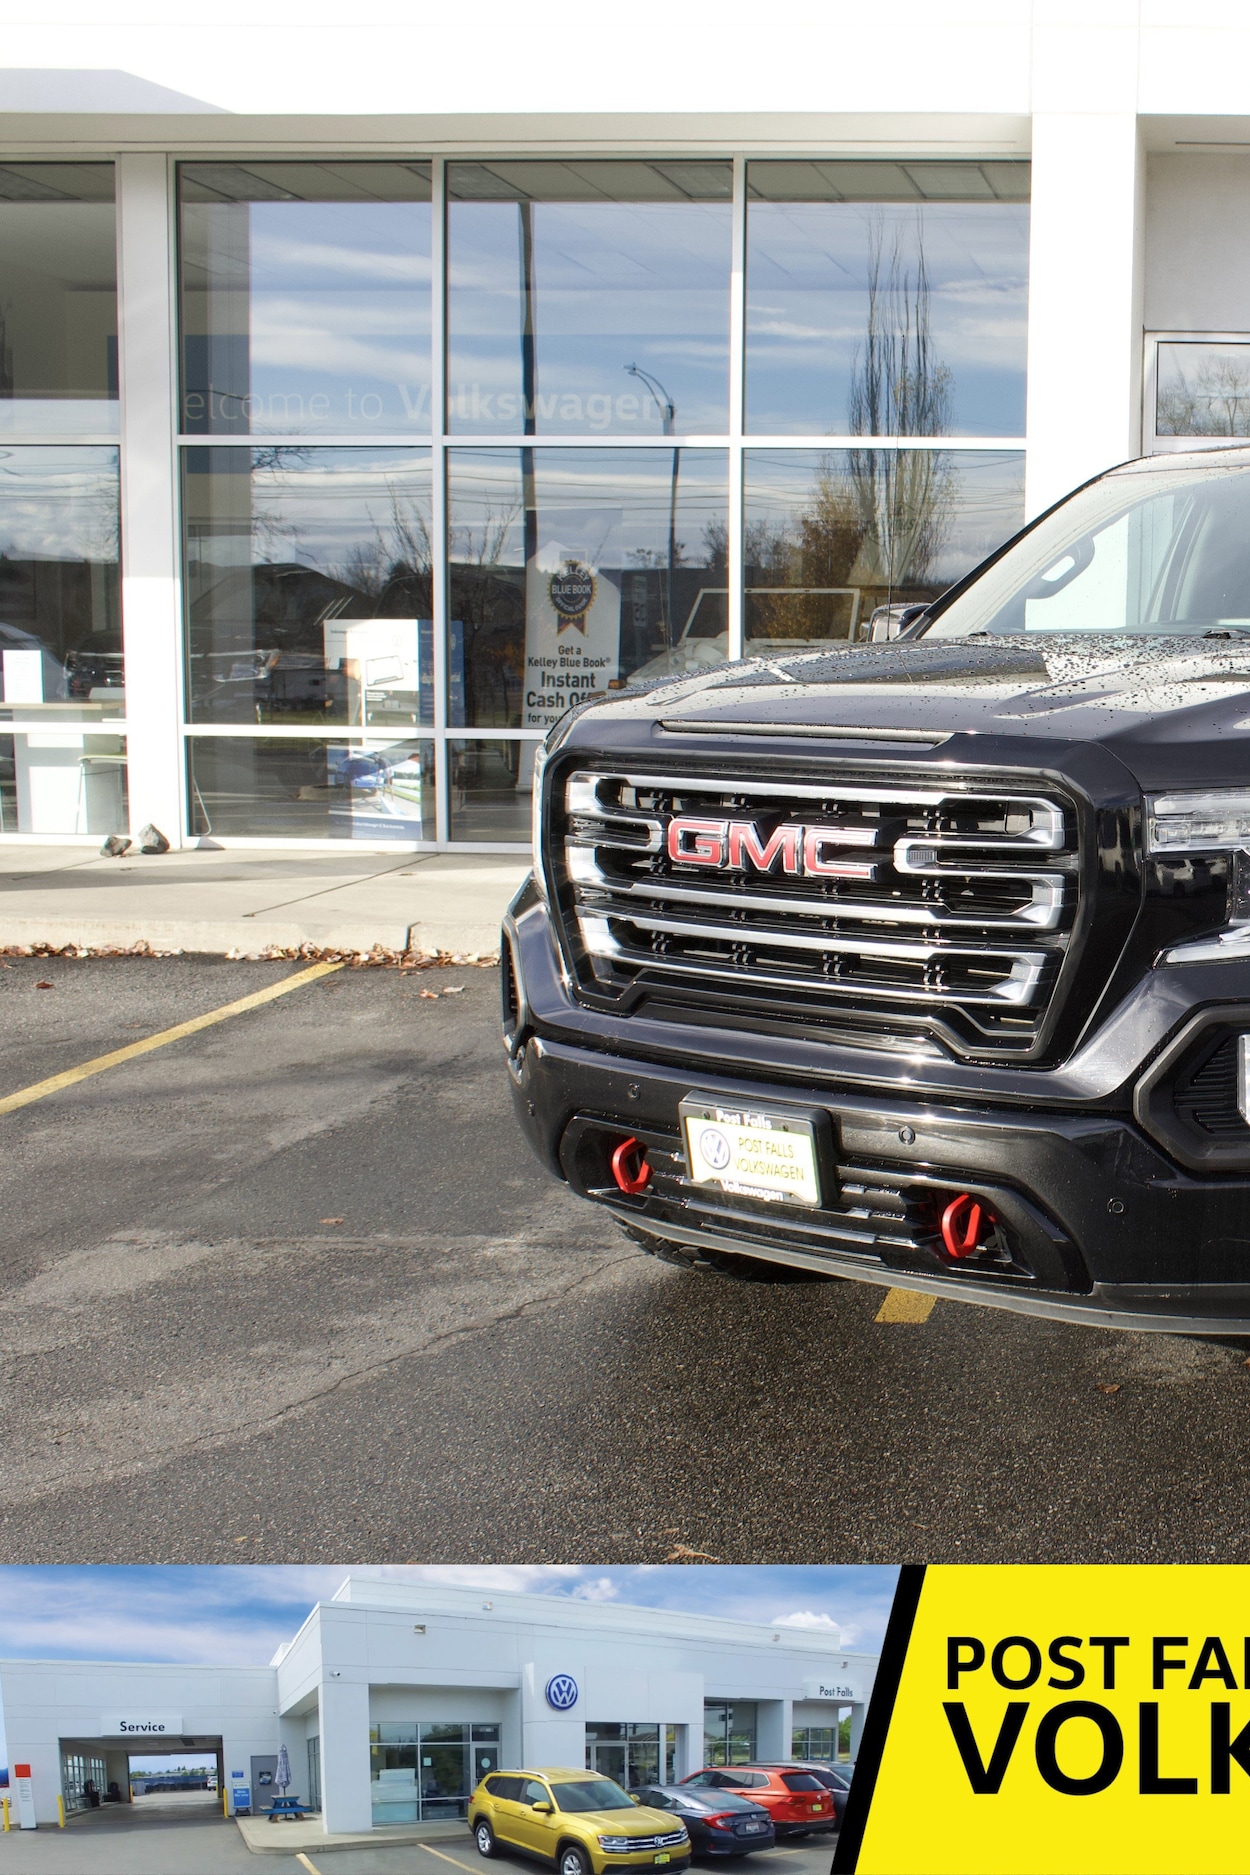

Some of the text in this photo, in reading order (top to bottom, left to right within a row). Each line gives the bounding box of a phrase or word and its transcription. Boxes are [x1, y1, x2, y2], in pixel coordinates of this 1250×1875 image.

[344, 387, 384, 420] to
[551, 584, 592, 595] BLUE BOOK
[558, 645, 582, 656] Get a
[528, 656, 557, 669] Kelley
[560, 657, 581, 668] Blue
[541, 671, 596, 688] Instant
[527, 691, 565, 708] Cash
[528, 713, 542, 723] for
[668, 815, 878, 880] GMC
[716, 1109, 772, 1130] Post Falls
[738, 1136, 794, 1158] POST FALLS
[734, 1158, 804, 1181] VOLKSWAGEN
[720, 1179, 784, 1201] Volkswagen
